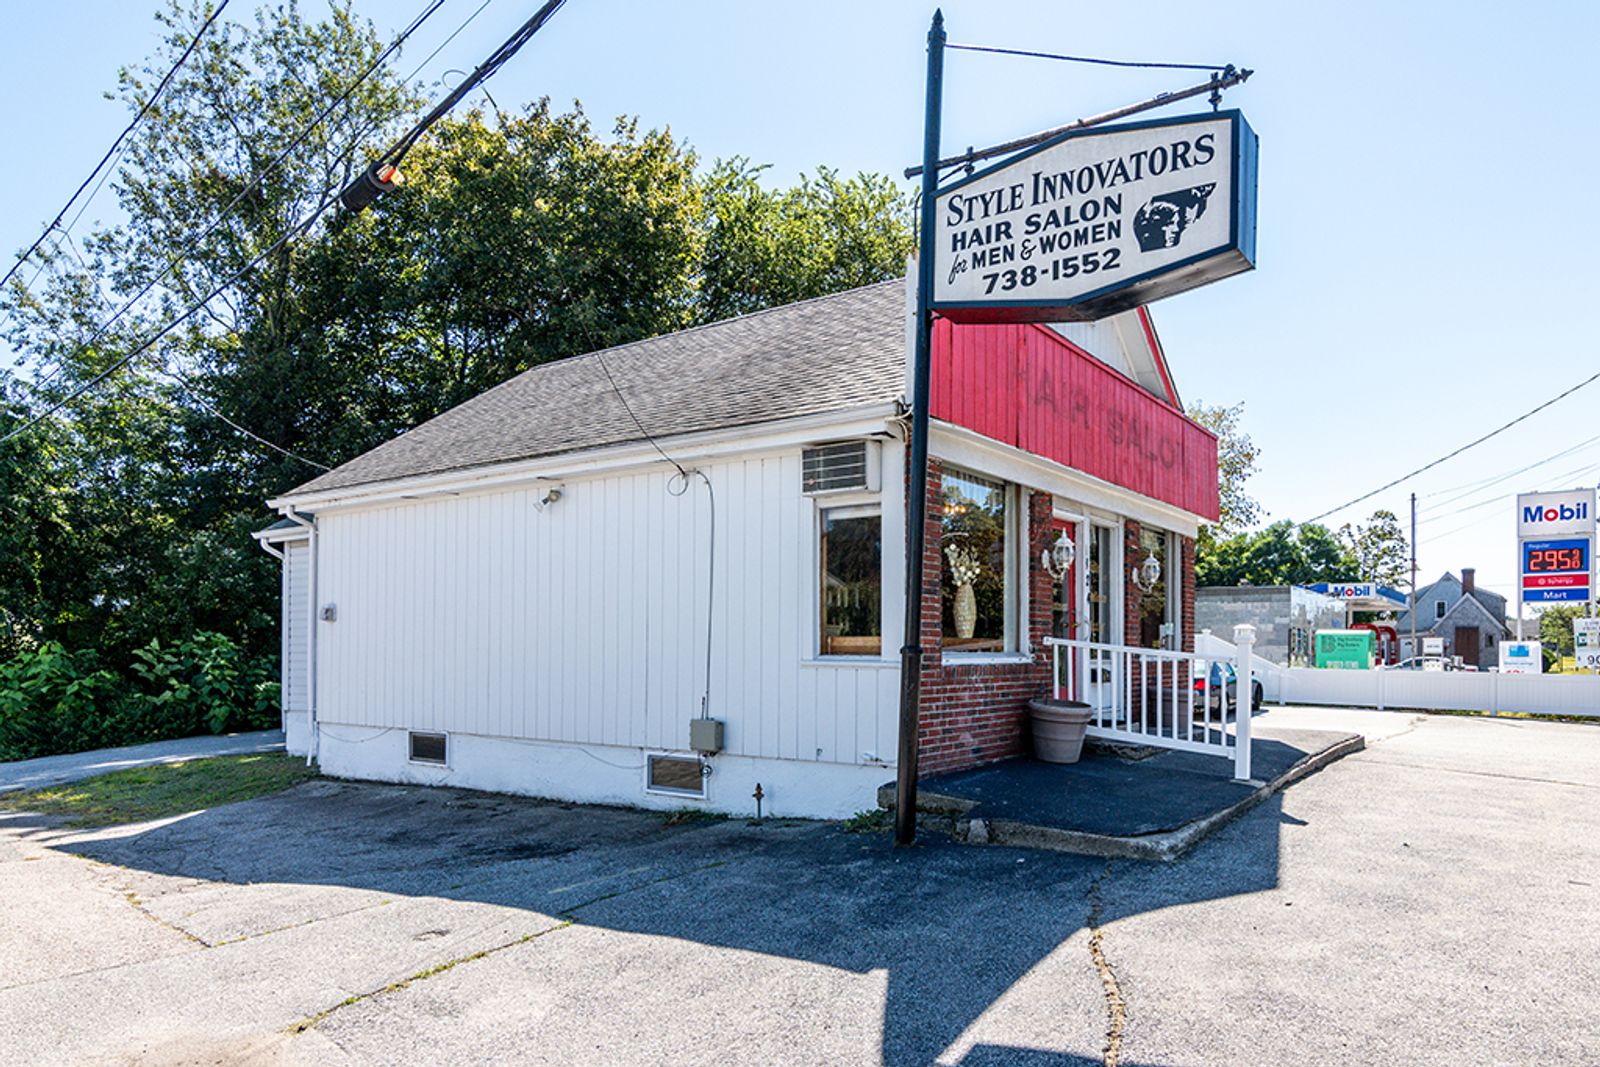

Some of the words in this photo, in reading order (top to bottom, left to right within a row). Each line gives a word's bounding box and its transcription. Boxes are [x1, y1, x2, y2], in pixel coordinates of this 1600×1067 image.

[946, 183, 1025, 227] STYLE
[1030, 133, 1216, 206] INNOVATORS
[952, 220, 1013, 252] HAIR
[1024, 193, 1123, 235] SALON
[949, 253, 968, 285] for
[971, 243, 1016, 269] MEN
[1020, 238, 1037, 260] &
[1039, 219, 1122, 254] WOMEN
[982, 249, 1121, 295] 738-1552
[1523, 502, 1587, 523] Mobil
[1334, 585, 1370, 597] Mobil
[1543, 591, 1568, 600] Mart
